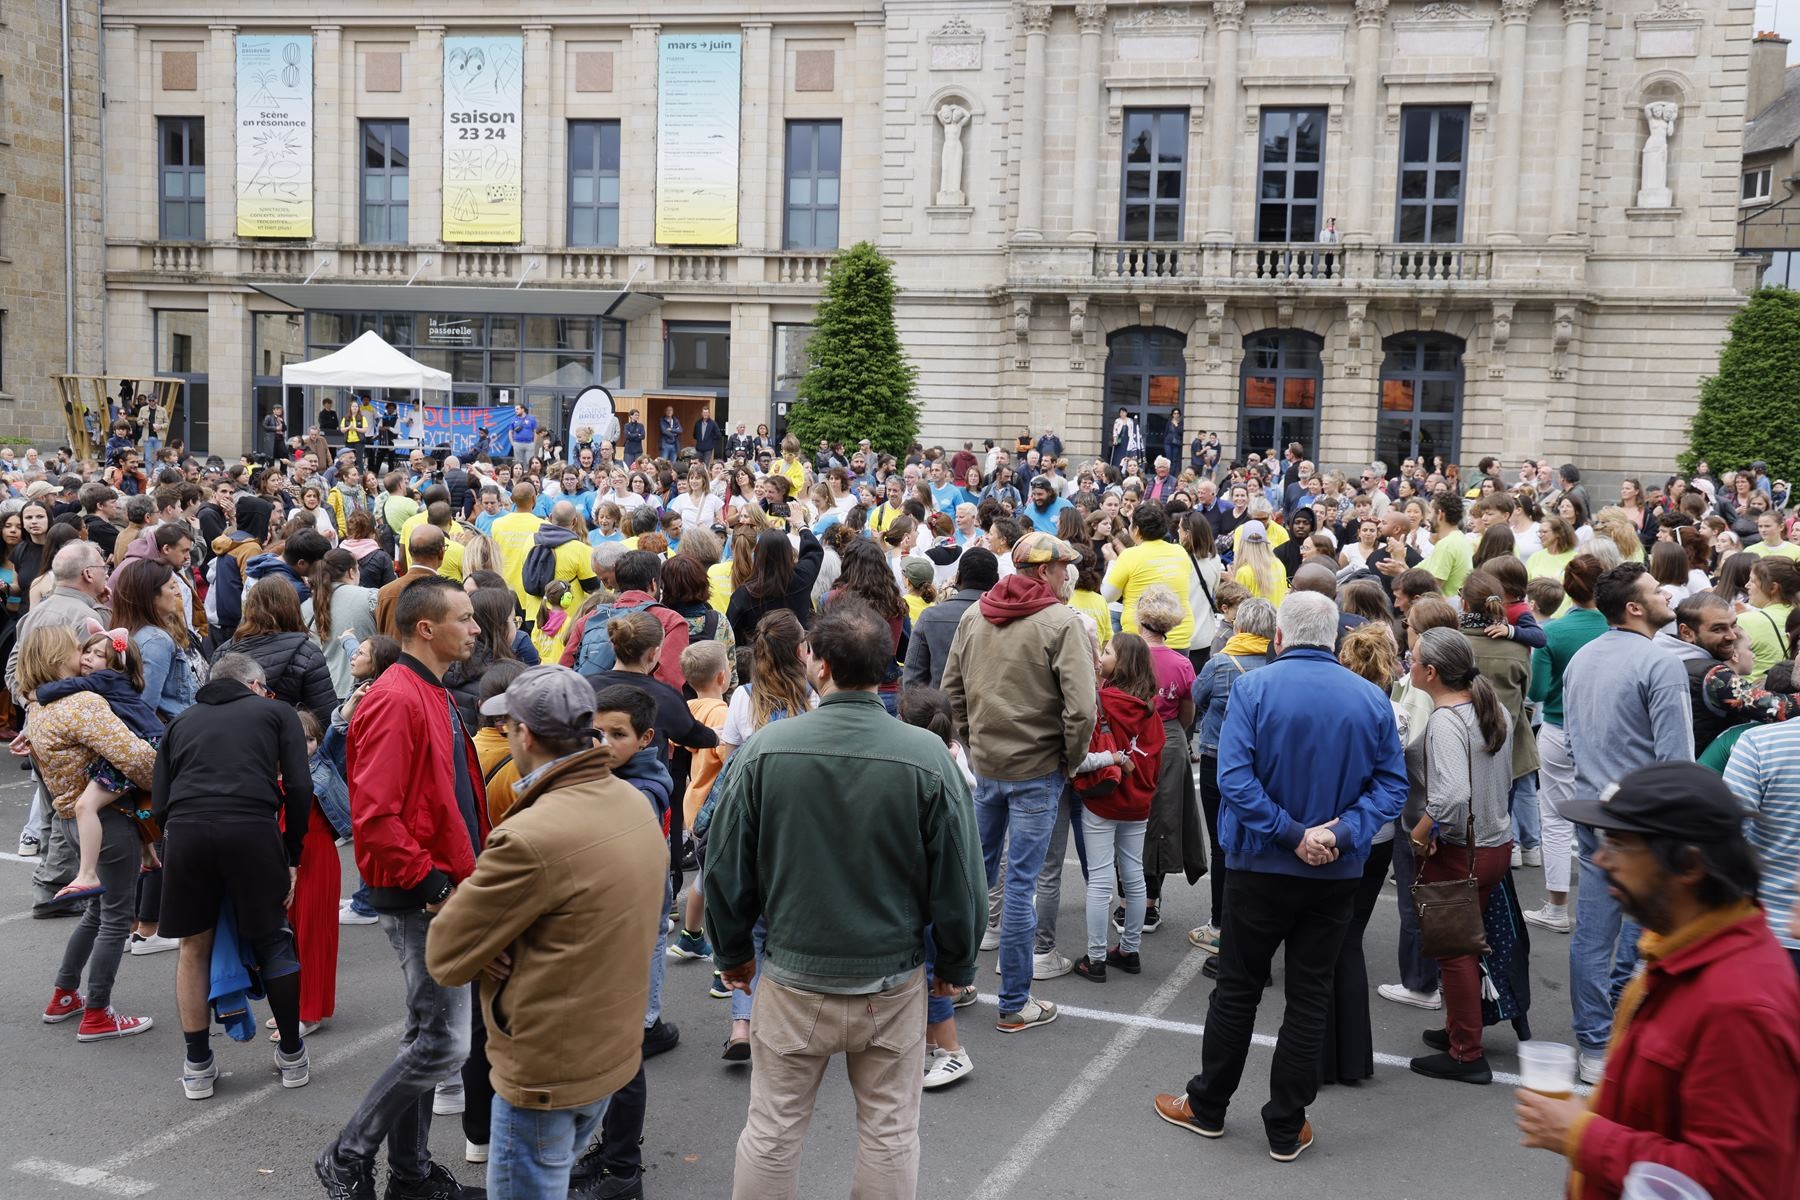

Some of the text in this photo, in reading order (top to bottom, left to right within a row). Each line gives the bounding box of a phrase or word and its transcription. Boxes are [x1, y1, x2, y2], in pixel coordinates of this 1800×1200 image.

[709, 40, 732, 51] juin
[260, 110, 289, 119] Scène
[450, 109, 515, 124] saison
[256, 119, 306, 127] résonance
[459, 127, 506, 140] 23 24
[429, 317, 437, 326] la
[428, 326, 472, 335] passerelle
